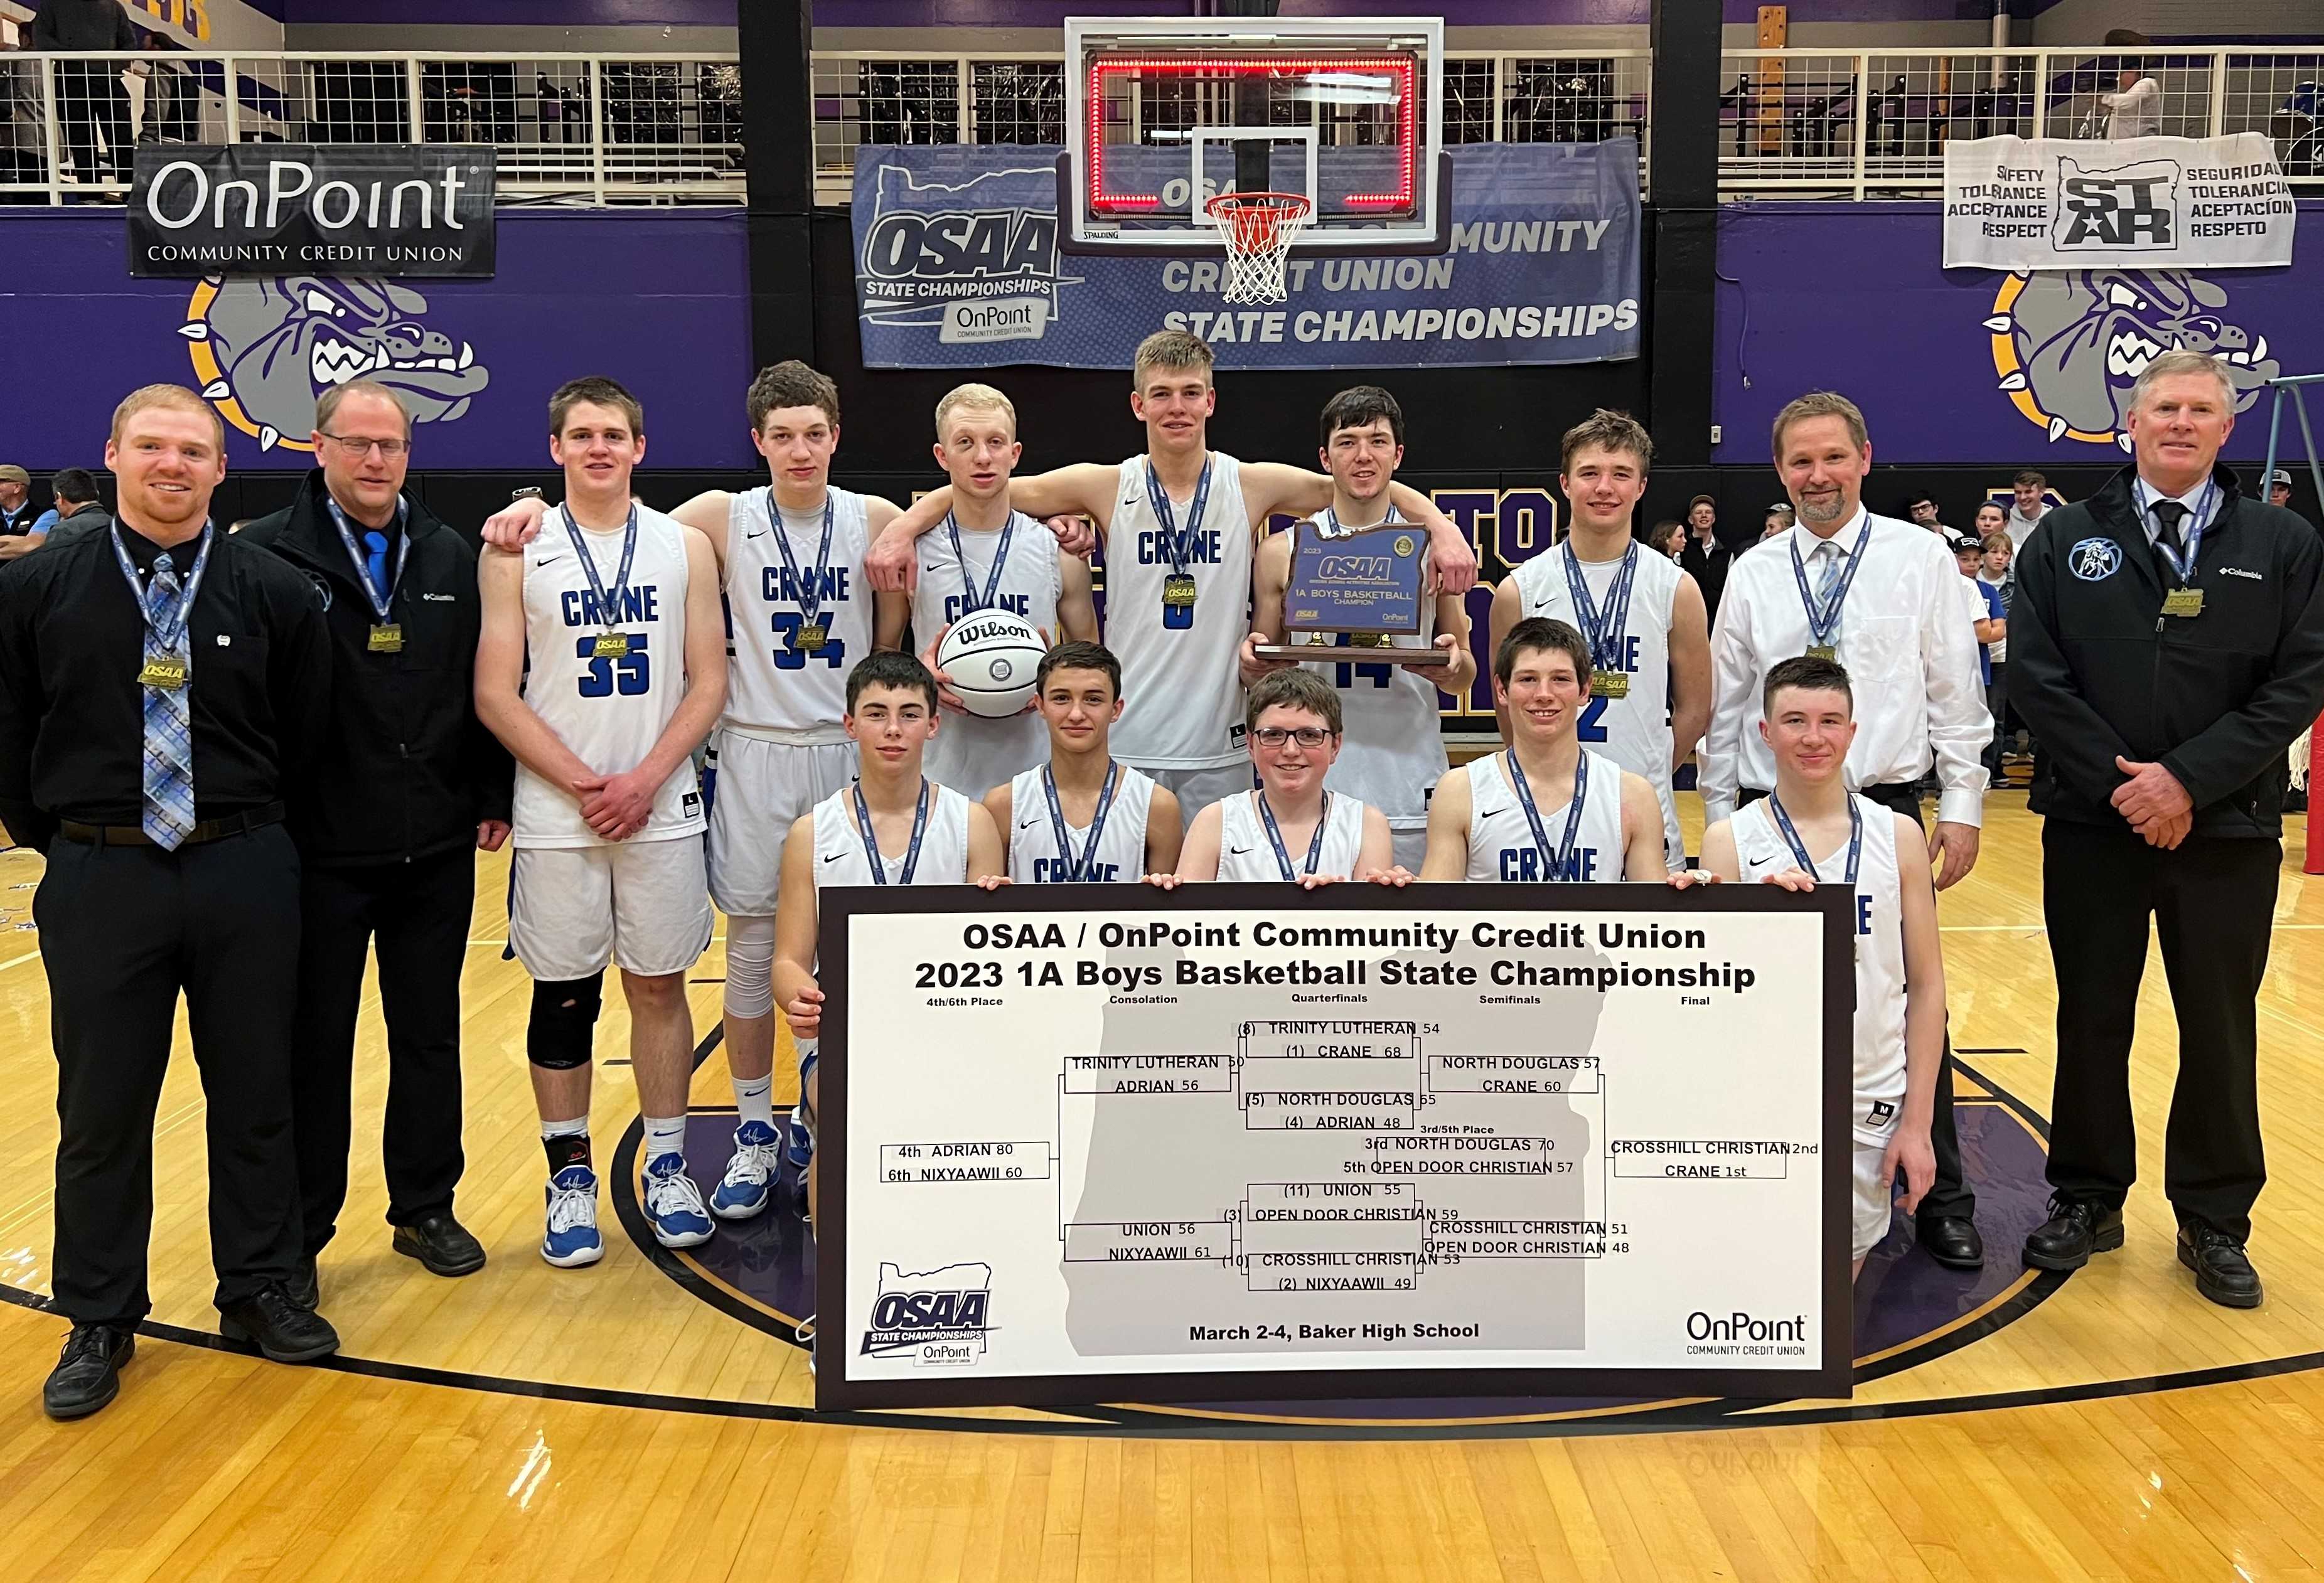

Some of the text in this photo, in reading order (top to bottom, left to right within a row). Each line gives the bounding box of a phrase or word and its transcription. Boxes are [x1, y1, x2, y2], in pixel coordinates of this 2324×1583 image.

[147, 161, 464, 230] OnPoint
[2188, 181, 2289, 198] TOLERANCIA
[1084, 231, 1118, 240] SPALDING
[1983, 222, 2047, 238] RESPECT
[2191, 221, 2267, 237] RESPETO
[867, 213, 1058, 279] OSAA
[148, 245, 463, 262] COMMUNITY CREDIT UNION
[1322, 258, 1455, 292] UNION
[866, 279, 1051, 297] STATE CHAMPIONSHIPS
[956, 305, 1032, 328] OnPoint
[1294, 299, 1639, 343] CHAMPIONSHIPS
[957, 326, 1032, 338] COMMUNITY CREDIT UNION
[1319, 556, 1392, 581] OSAA
[2228, 568, 2263, 580] Columbia
[1169, 588, 1195, 597] OSAA
[1295, 589, 1413, 600] 1A BOYS BASKETBALL
[1382, 613, 1408, 621] OnPoint
[798, 632, 824, 642] OSAA
[958, 622, 1032, 645] Wilson
[596, 639, 626, 649] OSAA
[771, 612, 845, 669] 34
[144, 665, 184, 679] OSAA
[577, 633, 650, 698] 35
[963, 921, 1705, 954] OSAA / OnPoint Community Credit Union
[915, 959, 1755, 993] 2023 1A Boys Basketball State Championship
[926, 996, 1003, 1006] 4th/6th Place
[1110, 994, 1178, 1005] Consolation
[1292, 993, 1368, 1004] Quarterfinals
[1479, 994, 1541, 1005] Semifinals
[1681, 996, 1710, 1006] Final
[1238, 1022, 1440, 1037] (8) TRINITY LUTHERAN 54
[1287, 1045, 1401, 1058] (1) CRANE 68
[1072, 1056, 1245, 1069] TRINITY LUTHERAN 50
[1443, 1057, 1600, 1069] NORTH DOUGLAS 57
[1115, 1080, 1199, 1093] ADRIAN 56
[1482, 1080, 1561, 1092] CRANE 60
[1246, 1094, 1436, 1107] (5) NORTH DOUGLAS 65
[1285, 1116, 1400, 1129] (4) ADRIAN 48
[1420, 1126, 1494, 1134] 3rd/5th Place
[899, 1144, 1013, 1158] 4th ADRIAN 80
[1364, 1138, 1555, 1151] 3rd NORTH DOUGLAS 70
[1611, 1141, 1818, 1154] CROSSHILL CHRISTIAN 2nd
[1343, 1161, 1573, 1173] 5th OPEN DOOR CHRISTIAN 57
[1665, 1165, 1747, 1177] CRANE 1st
[889, 1167, 1022, 1181] 6th NIXYAAWII 60
[1284, 1185, 1400, 1198] (11) UNION 55
[1224, 1208, 1458, 1223] (3) OPEN DOOR CHRISTIAN 59
[1123, 1224, 1195, 1236] UNION 56
[1430, 1222, 1628, 1234] CROSSHILL CHRISTIAN 51
[1109, 1247, 1211, 1261] NIXYAAWII 61
[1424, 1242, 1629, 1254] OPEN DOOR CHRISTIAN 48
[1262, 1254, 1350, 1266] CROSSHILL
[1355, 1254, 1438, 1266] CHRISTIAN
[1443, 1254, 1460, 1264] 53
[1279, 1277, 1411, 1291] (2) NIXYAAWII 49
[871, 1290, 989, 1330] OSAA
[1189, 1323, 1479, 1342] March 2-4, Baker High School
[1687, 1311, 1805, 1341] OnPoint
[871, 1330, 983, 1342] STATE CHAMPIONSHIPS
[924, 1345, 970, 1358] OnPoint
[1687, 1345, 1805, 1356] COMMUNITY CREDIT UNION
